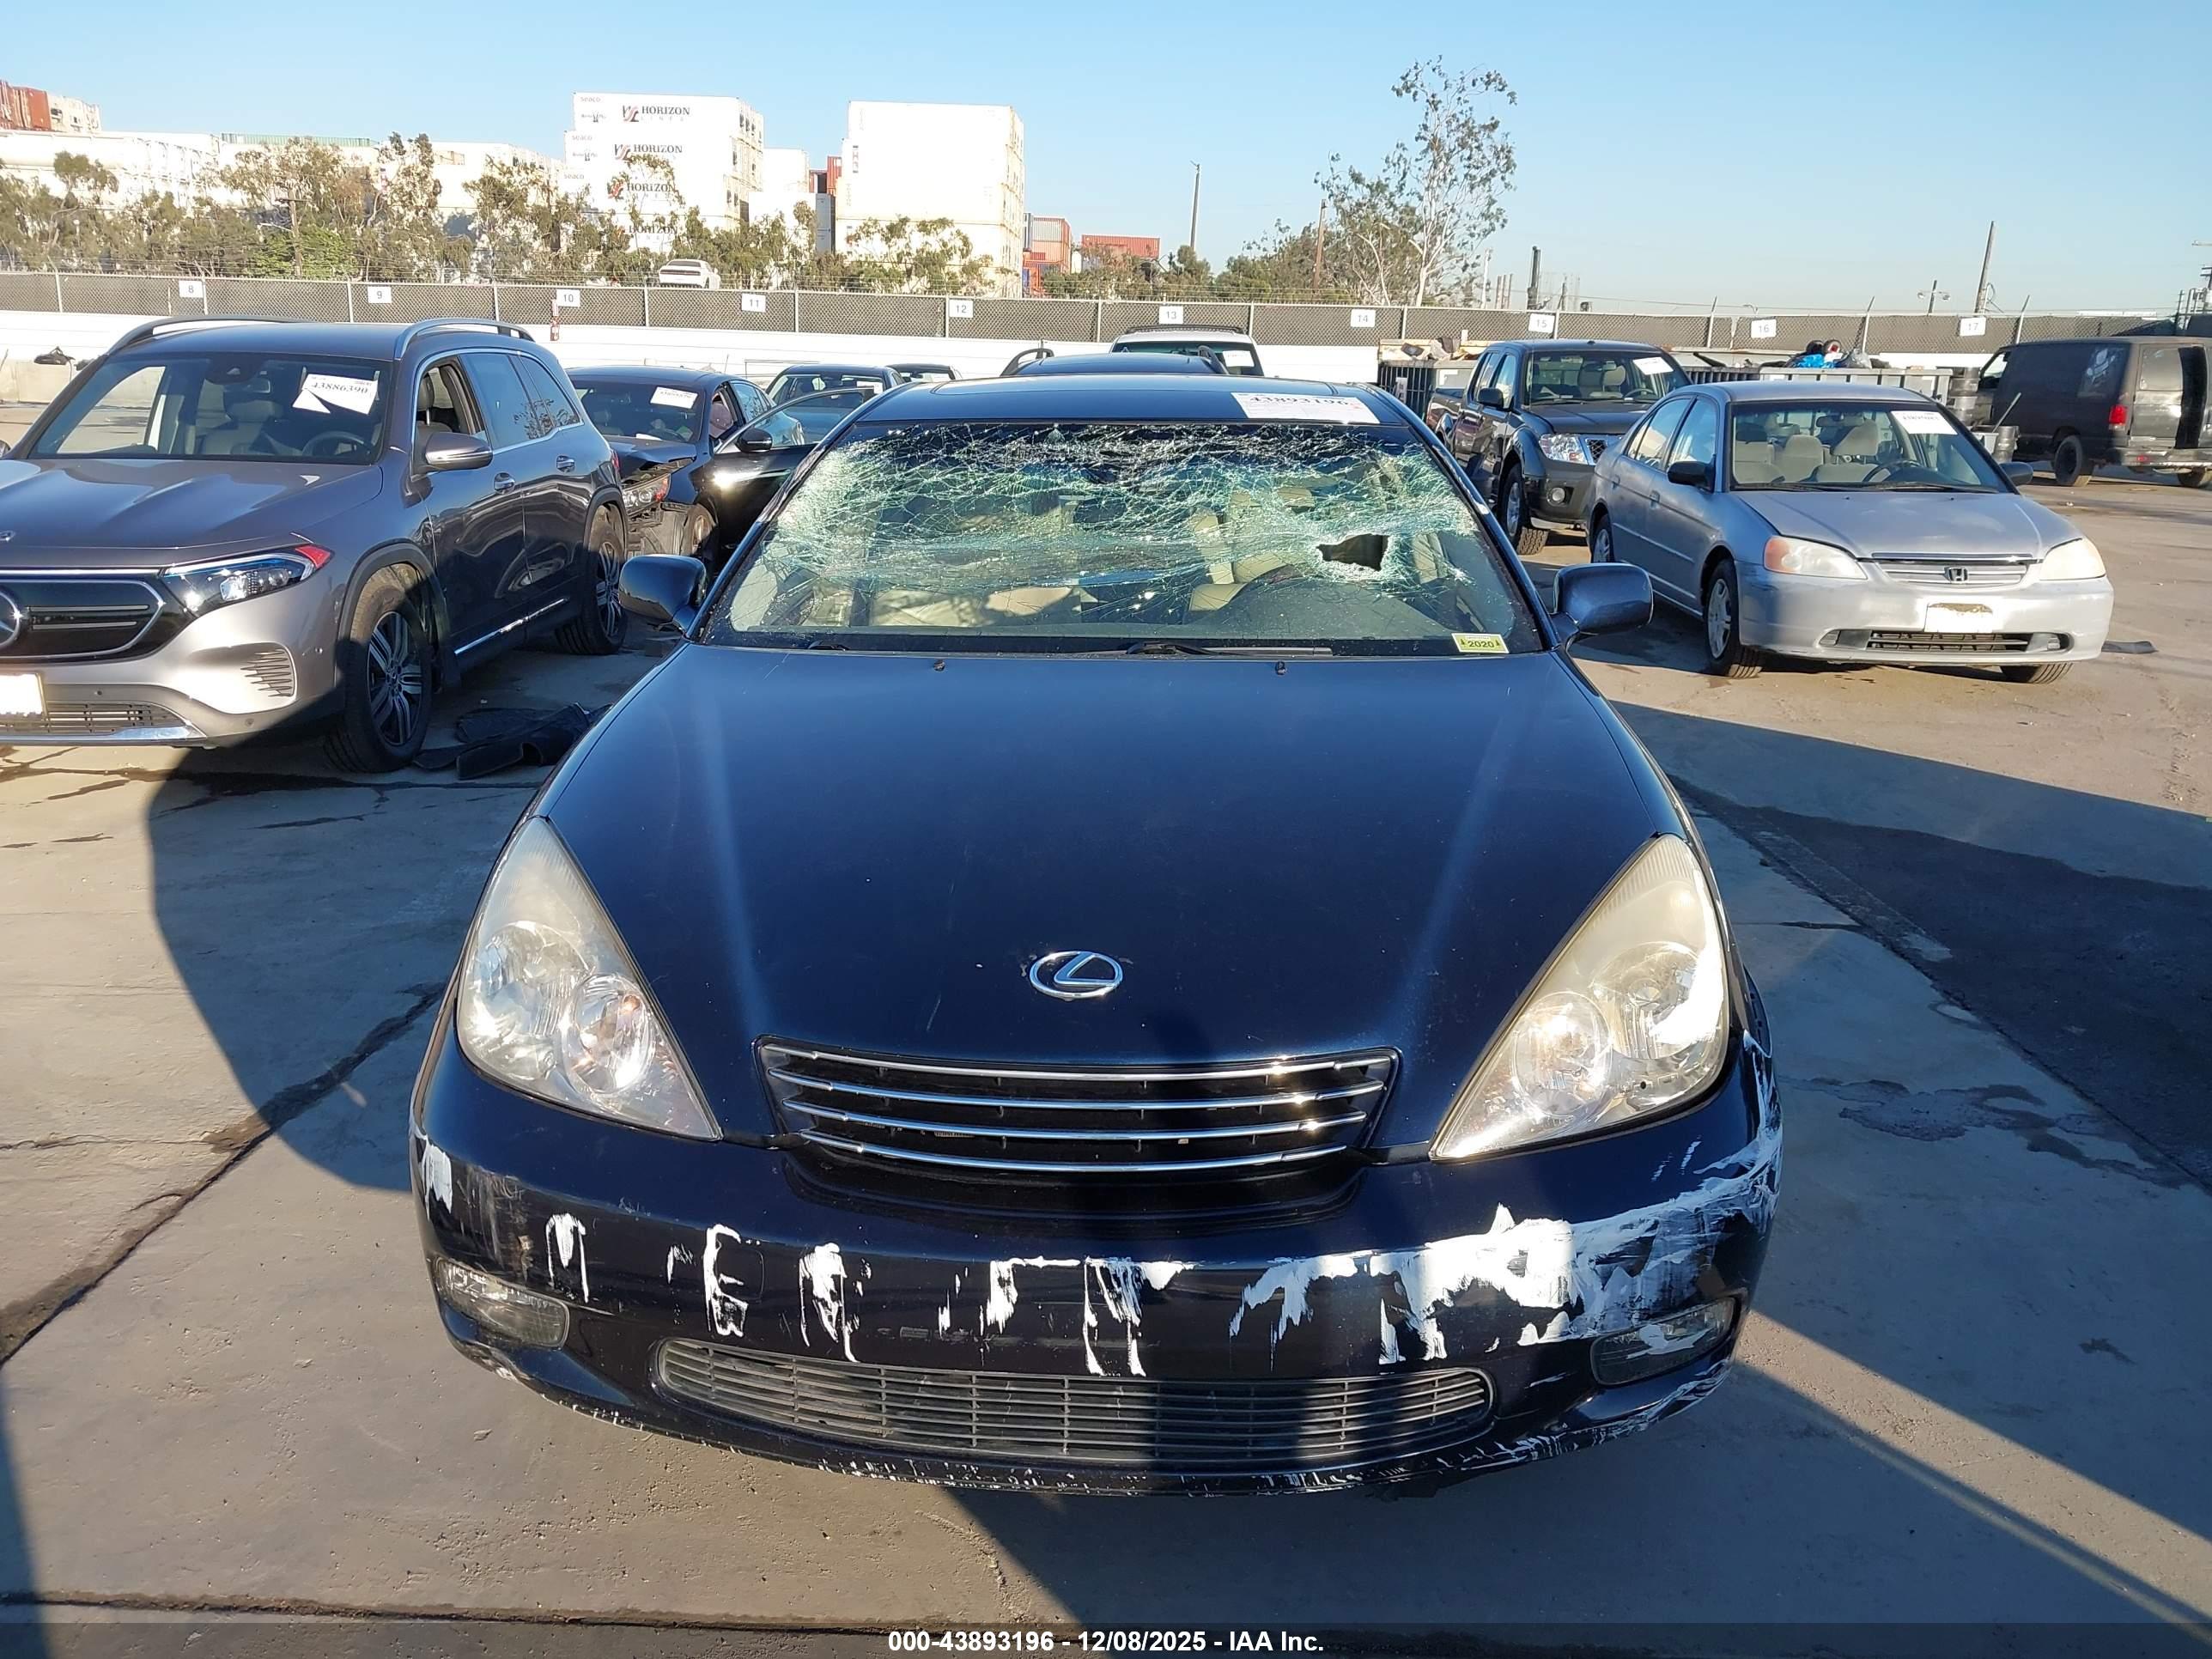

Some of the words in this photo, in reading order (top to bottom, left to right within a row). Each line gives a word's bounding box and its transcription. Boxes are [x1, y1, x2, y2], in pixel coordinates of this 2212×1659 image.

[641, 106, 690, 115] HORIZON
[633, 143, 683, 153] HORIZON
[627, 183, 676, 192] HORIZON
[563, 294, 574, 302] 10
[749, 299, 759, 307] 11
[956, 304, 967, 313] 12
[1166, 311, 1177, 319] 13
[1358, 314, 1368, 323] 14
[1536, 319, 1547, 328] 15
[1758, 324, 1770, 332] 16
[1968, 322, 1978, 331] 17
